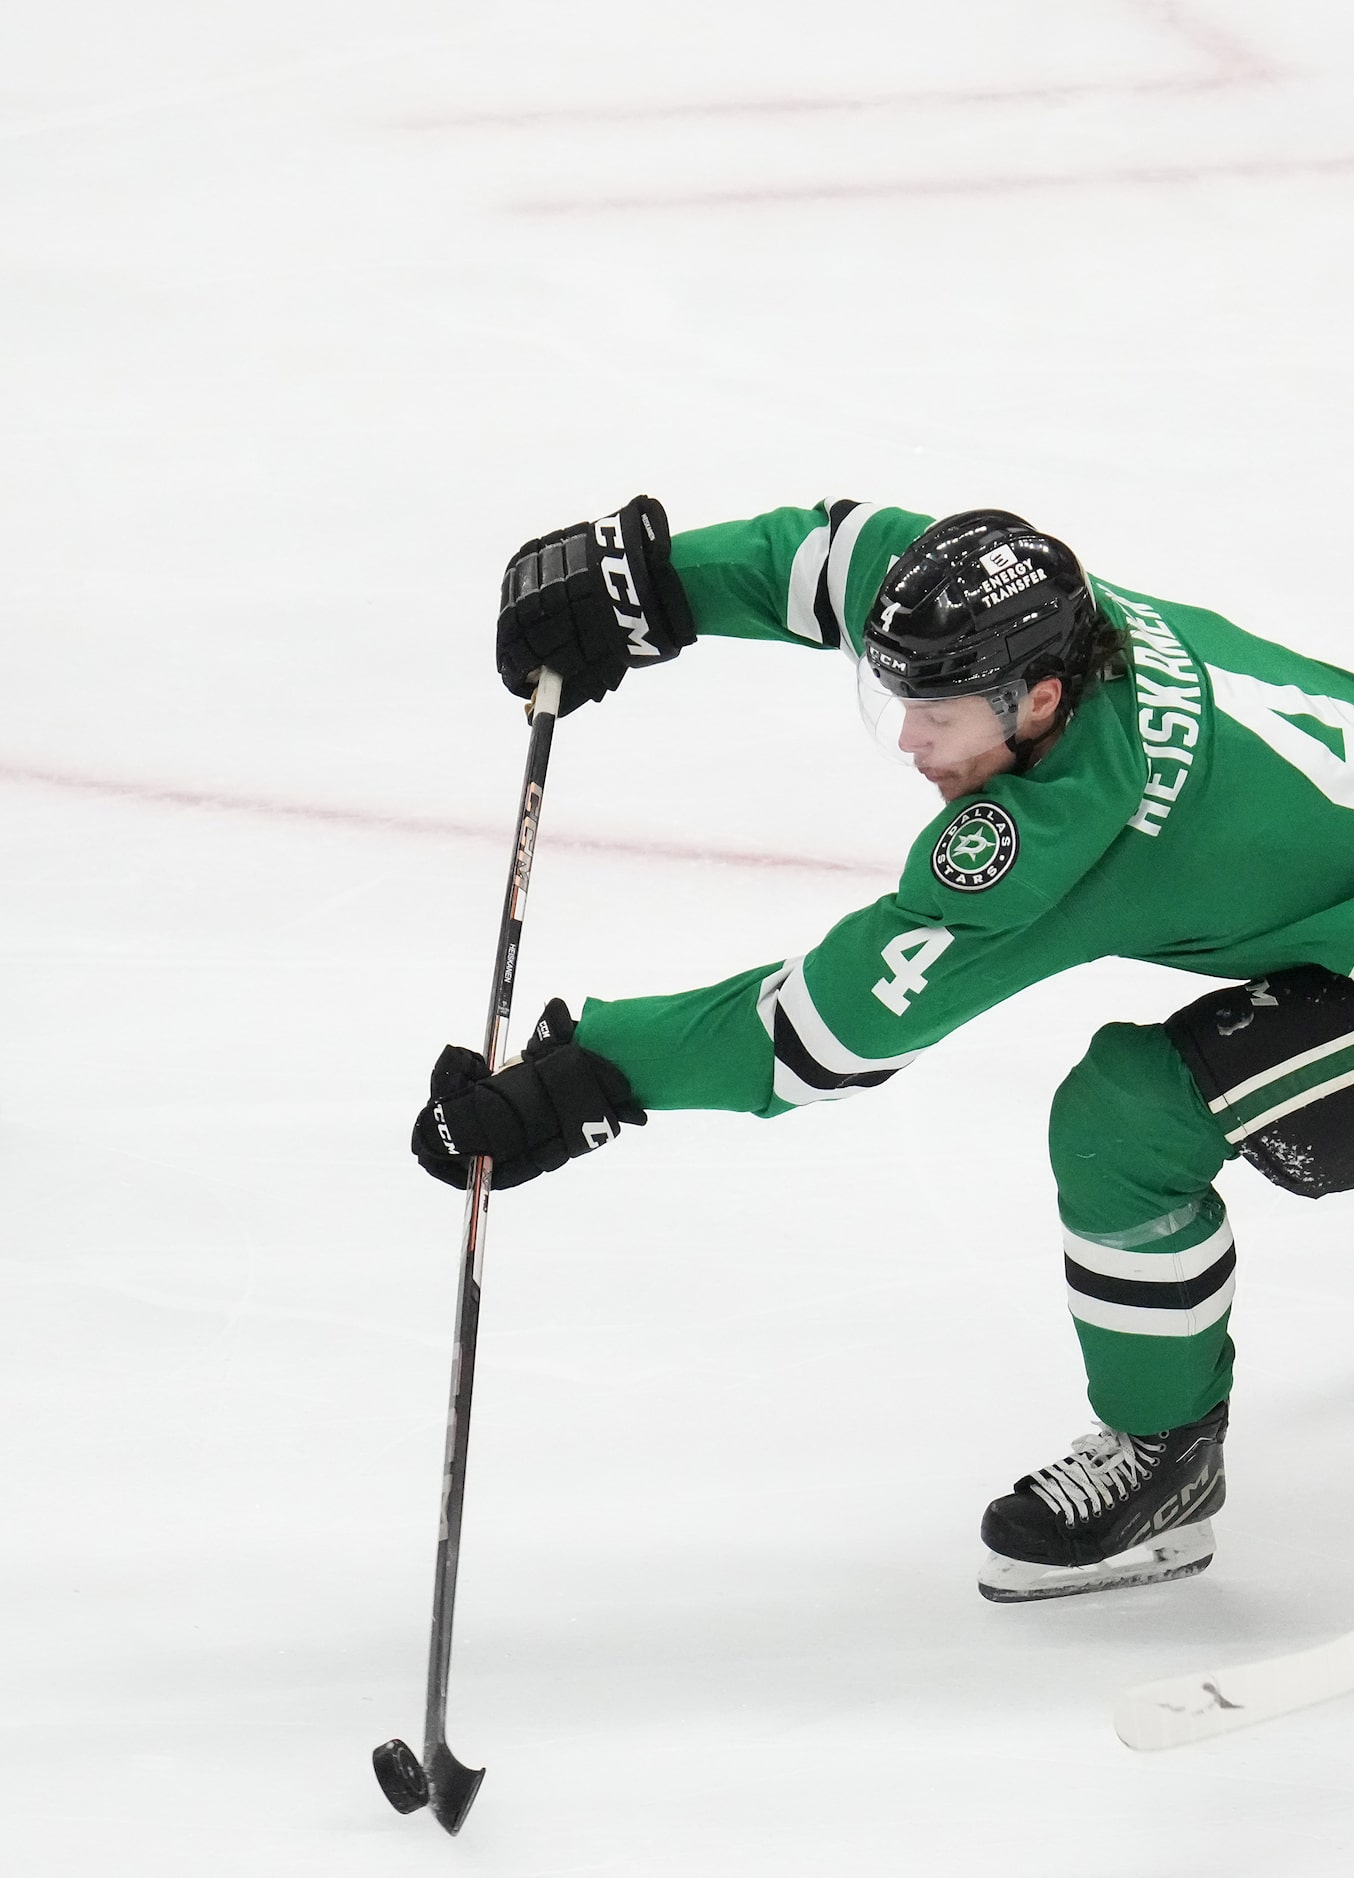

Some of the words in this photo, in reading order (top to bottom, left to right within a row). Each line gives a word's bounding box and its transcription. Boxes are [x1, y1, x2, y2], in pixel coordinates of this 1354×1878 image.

[594, 513, 661, 656] CCM
[981, 558, 1033, 593] ENERGY
[981, 568, 1047, 608] TRANSFER
[880, 602, 902, 632] 4
[869, 646, 907, 672] CCM
[512, 781, 543, 893] CCM
[948, 809, 1011, 847] DALLAS
[938, 854, 998, 884] STARS
[871, 926, 955, 1017] 4
[433, 1104, 460, 1155] CCM
